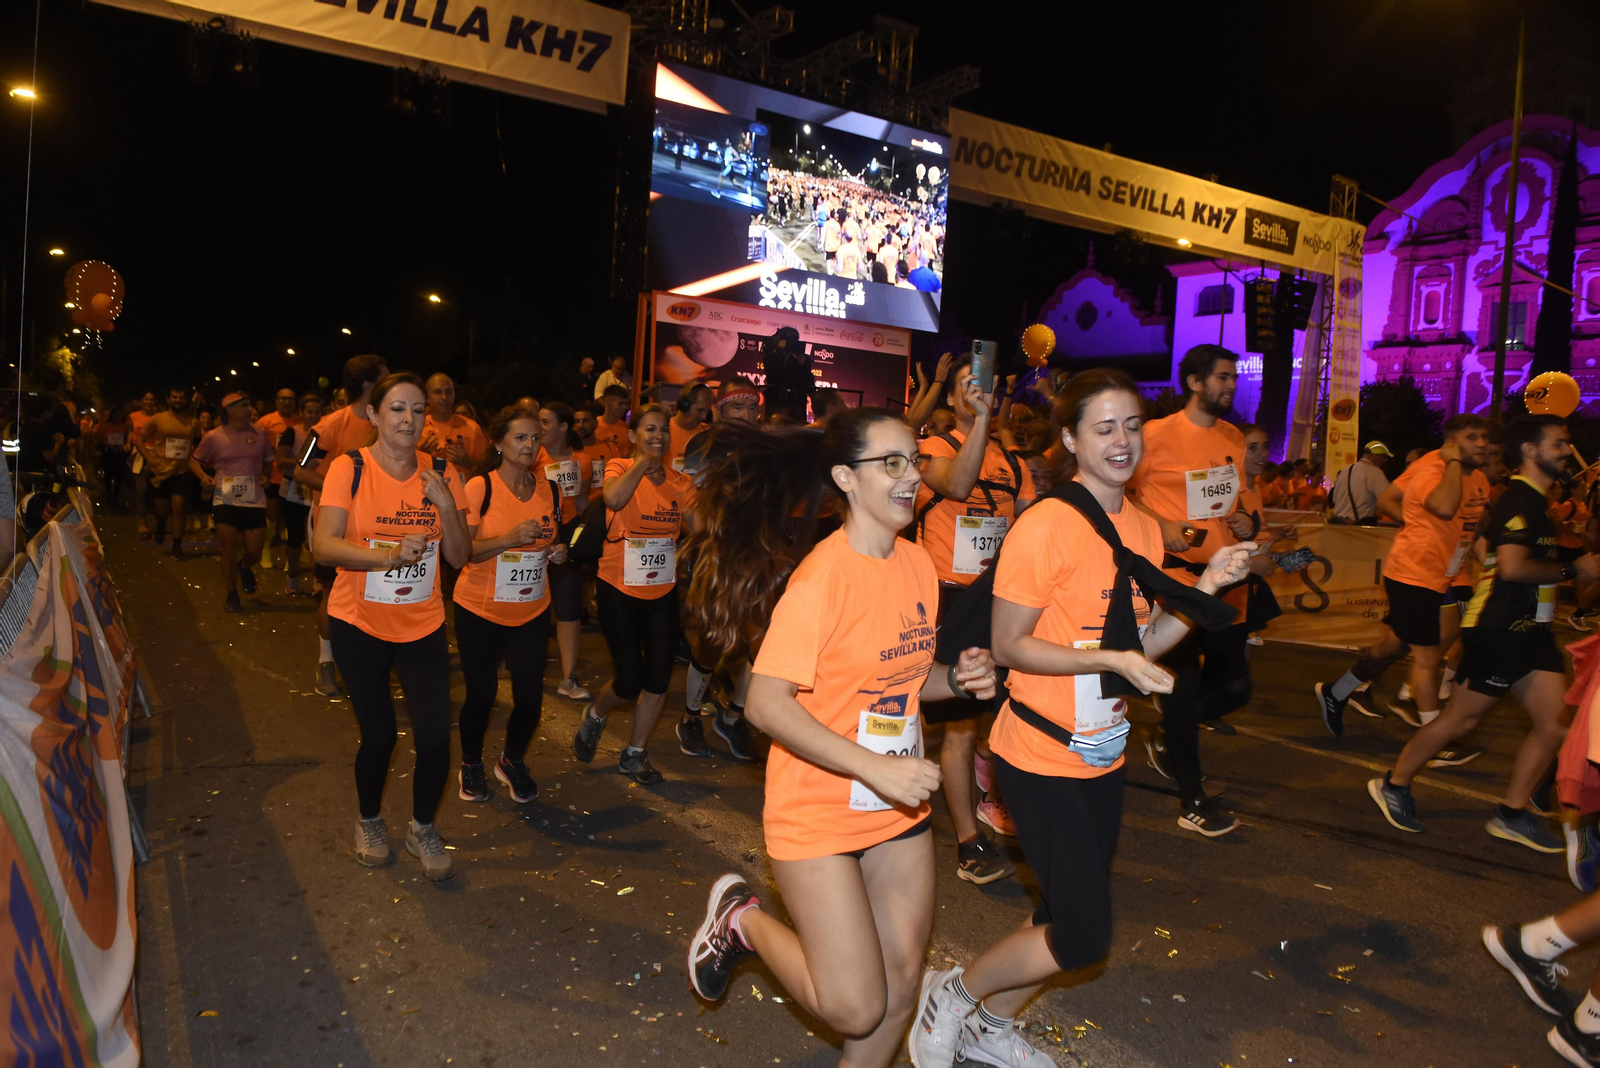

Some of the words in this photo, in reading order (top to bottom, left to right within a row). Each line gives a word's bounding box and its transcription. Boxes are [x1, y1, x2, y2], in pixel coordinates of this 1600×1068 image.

[313, 0, 490, 43] ILLA
[954, 136, 1092, 196] NOCTURNA
[1097, 175, 1185, 220] SEVILLA
[708, 310, 723, 319] ABC
[731, 315, 762, 326] Cruzcampo
[231, 484, 248, 492] 9753
[1200, 482, 1232, 498] 16495
[375, 516, 415, 525] SEVILLA
[395, 510, 436, 519] NOCTURNA
[641, 514, 667, 523] SEVILLA
[641, 554, 666, 566] 9749
[510, 567, 543, 582] 21732
[899, 625, 934, 643] NOCTURNA
[880, 642, 918, 662] SEVILLA
